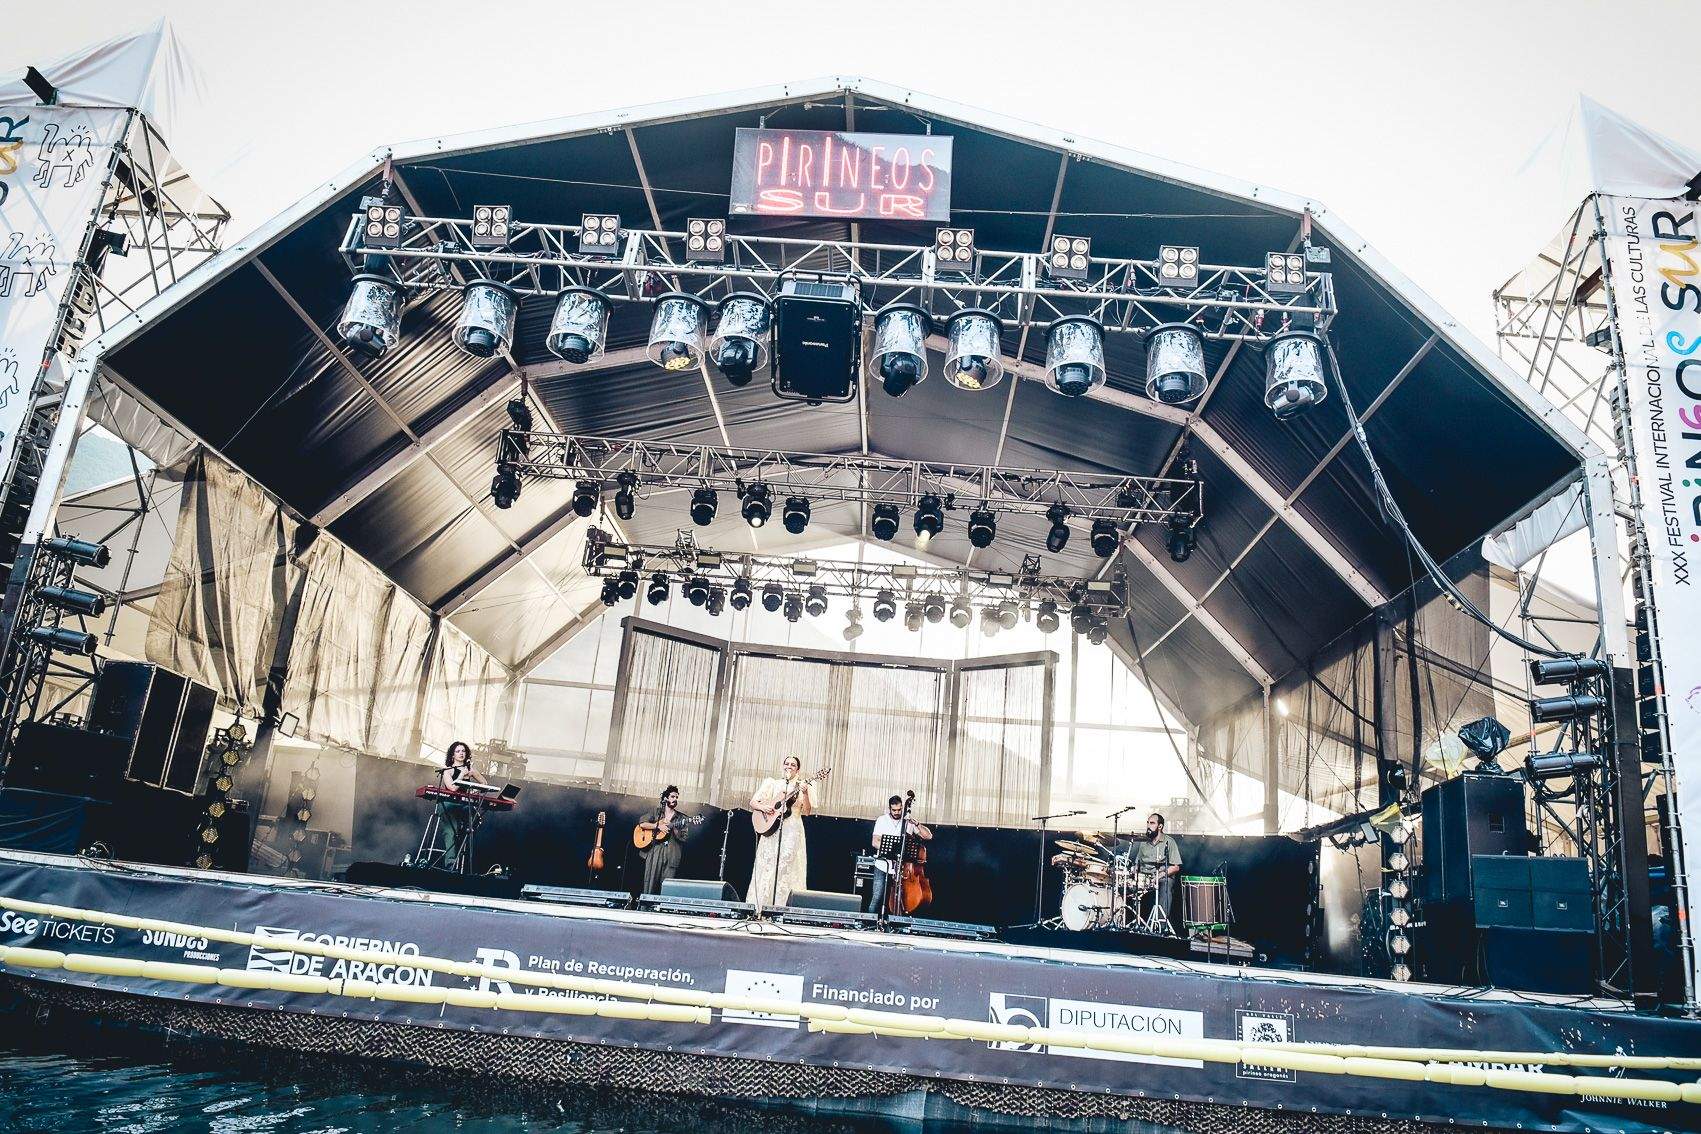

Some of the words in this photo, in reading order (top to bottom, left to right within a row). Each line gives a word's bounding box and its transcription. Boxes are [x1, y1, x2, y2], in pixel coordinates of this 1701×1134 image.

[756, 136, 936, 192] PIRINEOS
[756, 189, 926, 217] SUR
[1622, 206, 1644, 283] CULTURAS
[1633, 285, 1649, 313] LAS
[1642, 340, 1671, 469] INTERNACIONAL
[1658, 472, 1685, 547] FESTIVAL
[1671, 550, 1691, 586] XXX
[0, 911, 39, 935] See
[43, 920, 115, 944] TICKETS
[291, 955, 325, 977] DE
[528, 955, 560, 971] Plan
[564, 957, 583, 973] de
[587, 960, 695, 985] Recuperación,
[812, 983, 905, 1006] Financiado
[910, 995, 940, 1011] por
[1059, 1008, 1182, 1035] DIPUTACIÓN
[1580, 1094, 1622, 1105] JOHNNIE
[1627, 1097, 1668, 1109] WALKER
